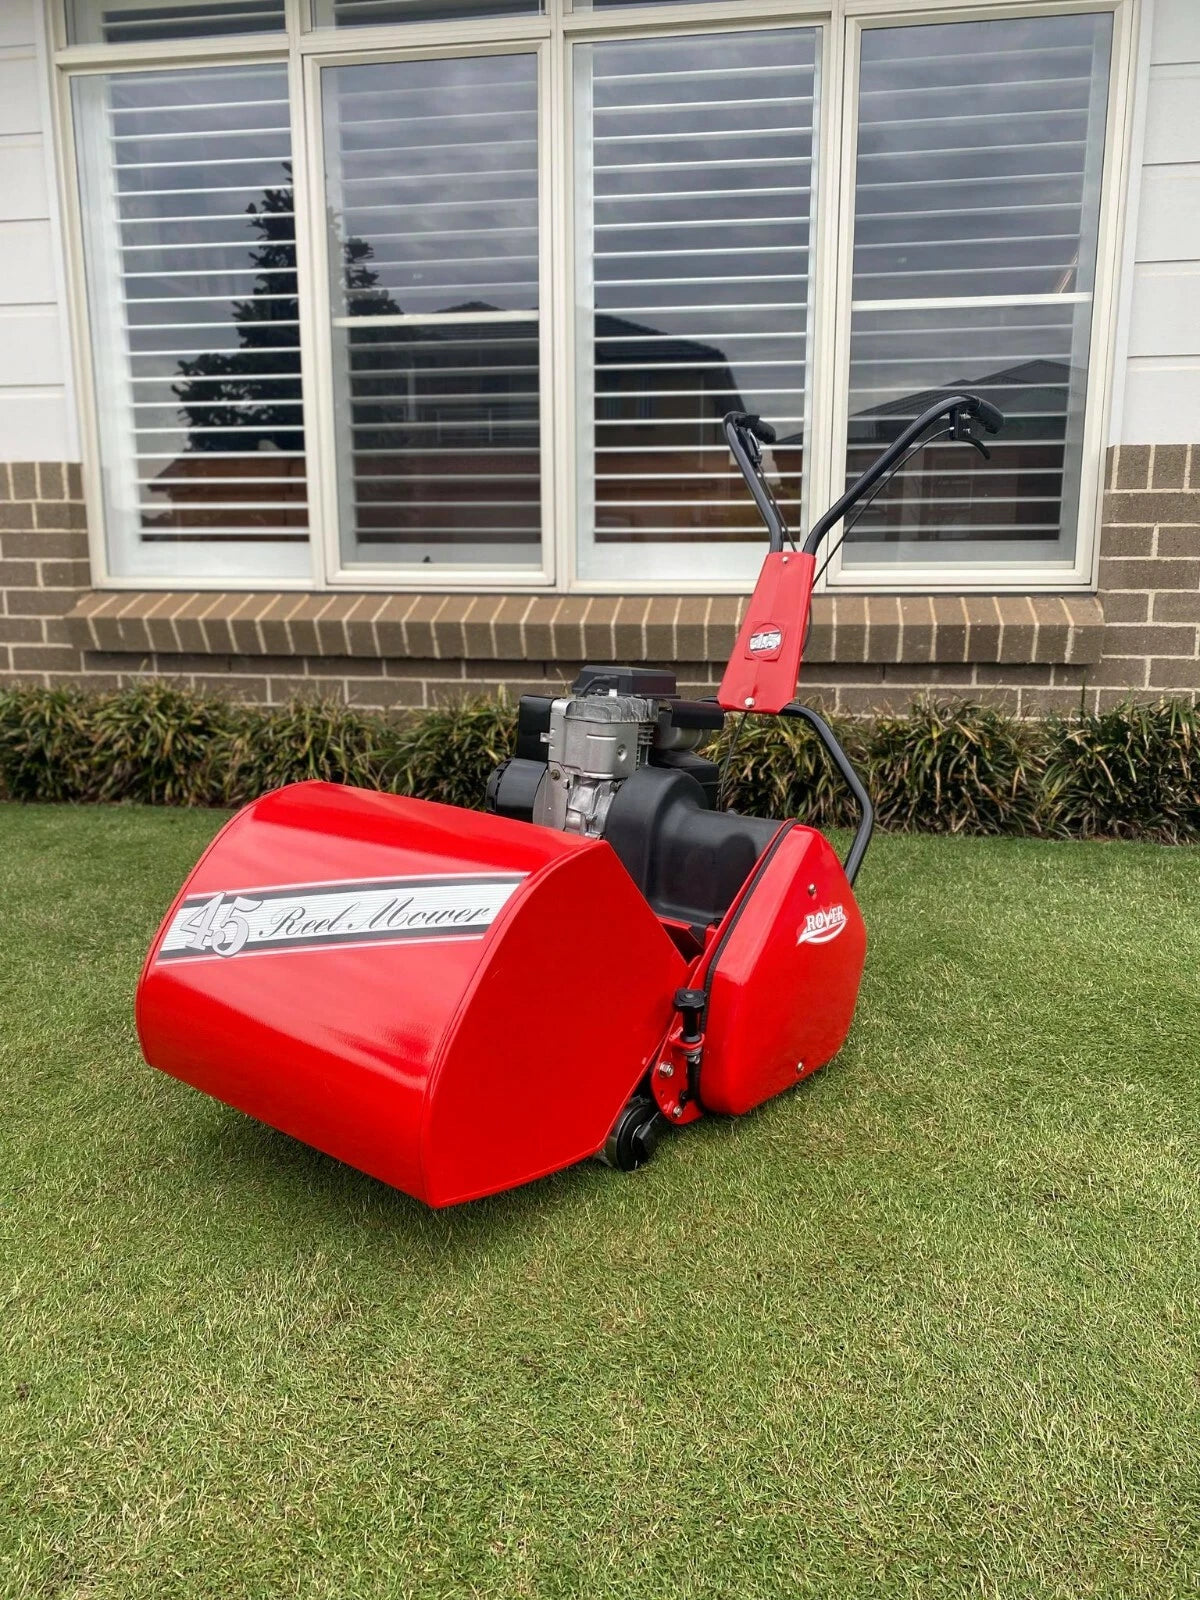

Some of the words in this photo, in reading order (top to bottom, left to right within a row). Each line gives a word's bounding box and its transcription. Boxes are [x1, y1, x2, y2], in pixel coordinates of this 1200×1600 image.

[180, 892, 263, 957] 45
[259, 901, 360, 938] Reel
[349, 896, 491, 931] Mower
[805, 905, 844, 932] ROVER
